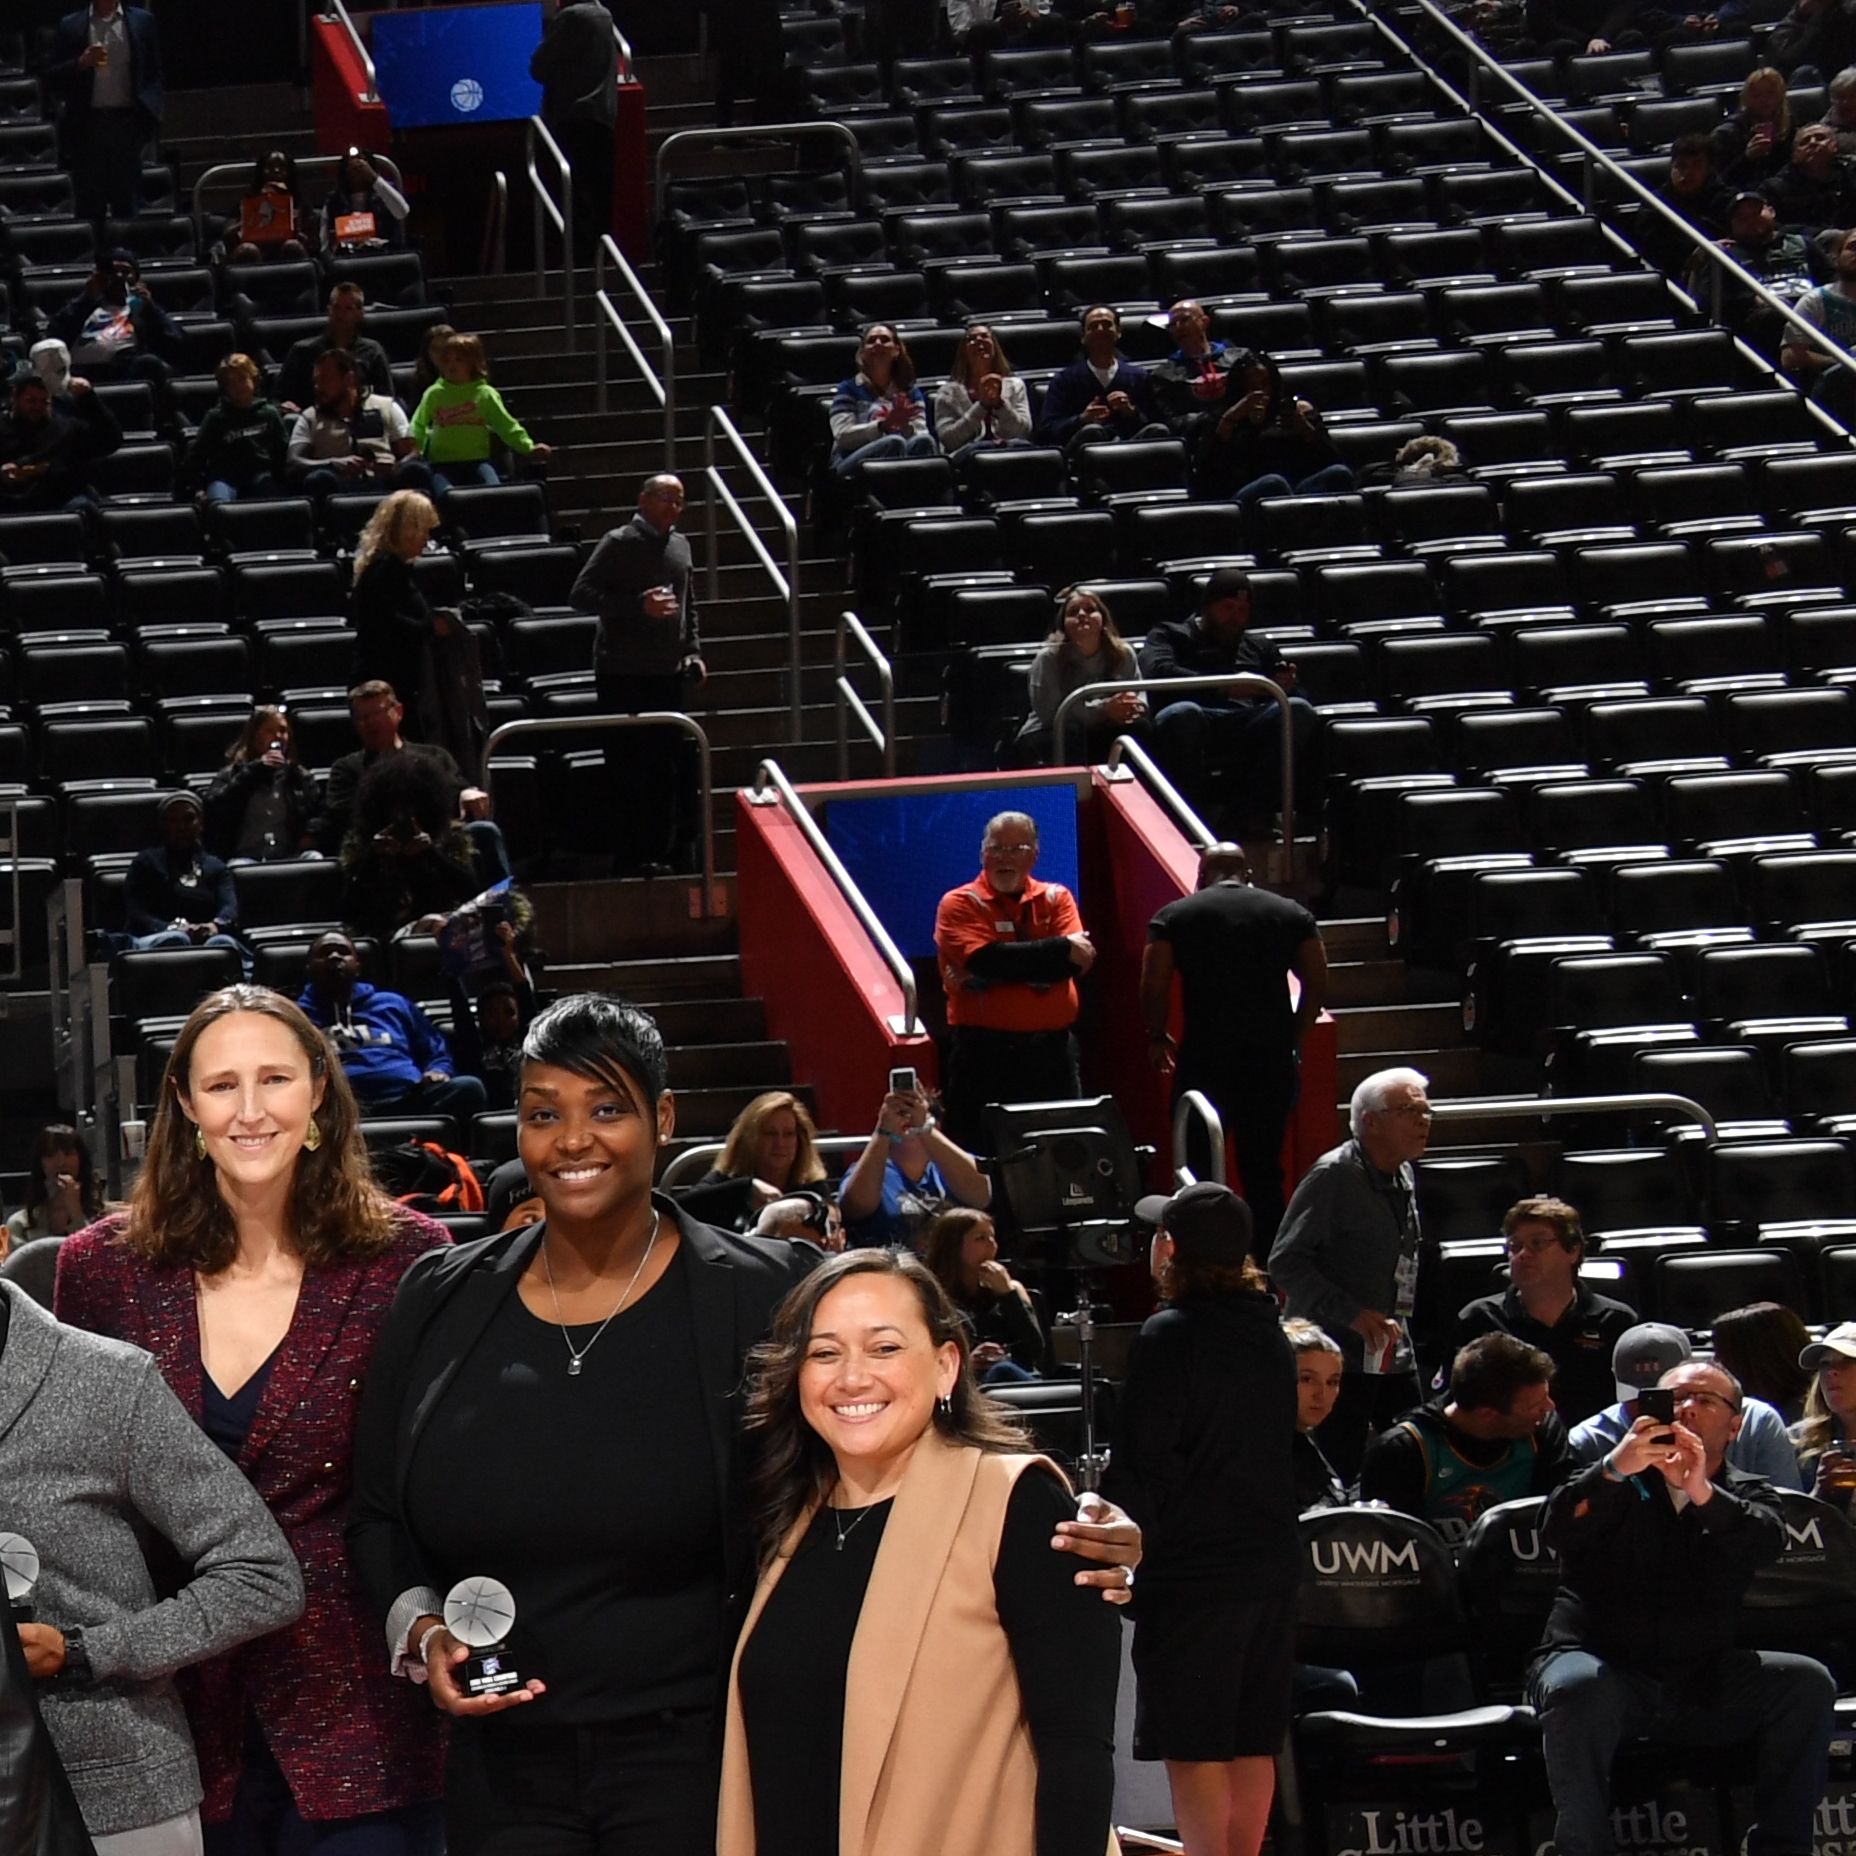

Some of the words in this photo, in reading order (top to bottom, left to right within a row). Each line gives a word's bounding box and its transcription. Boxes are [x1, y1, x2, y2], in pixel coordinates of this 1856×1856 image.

[1310, 1539, 1420, 1575] UWM
[1361, 1808, 1485, 1856] Little
[1609, 1800, 1688, 1846] ttle
